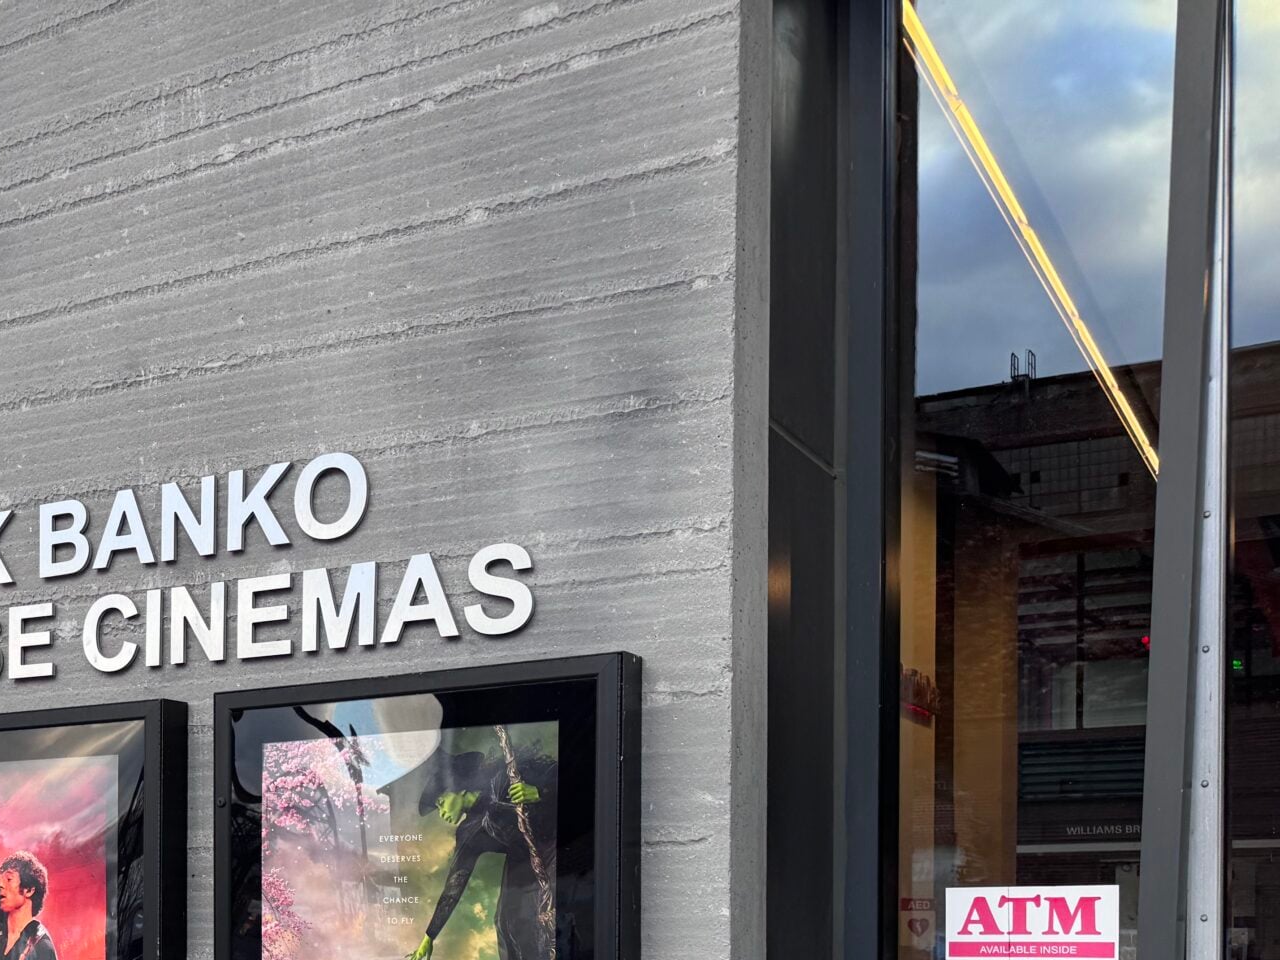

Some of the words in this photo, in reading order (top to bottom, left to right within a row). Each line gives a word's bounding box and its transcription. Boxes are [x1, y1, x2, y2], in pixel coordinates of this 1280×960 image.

[40, 451, 369, 579] BANKO
[83, 541, 536, 672] CINEMAS
[1066, 825, 1123, 836] WILLIAMS
[379, 834, 423, 842] EVERYONE
[380, 855, 421, 863] DESERVES
[907, 900, 930, 910] AED
[957, 894, 1102, 935] ATM
[979, 945, 1037, 954] AVAILABLE
[1040, 945, 1078, 955] INSIDE
